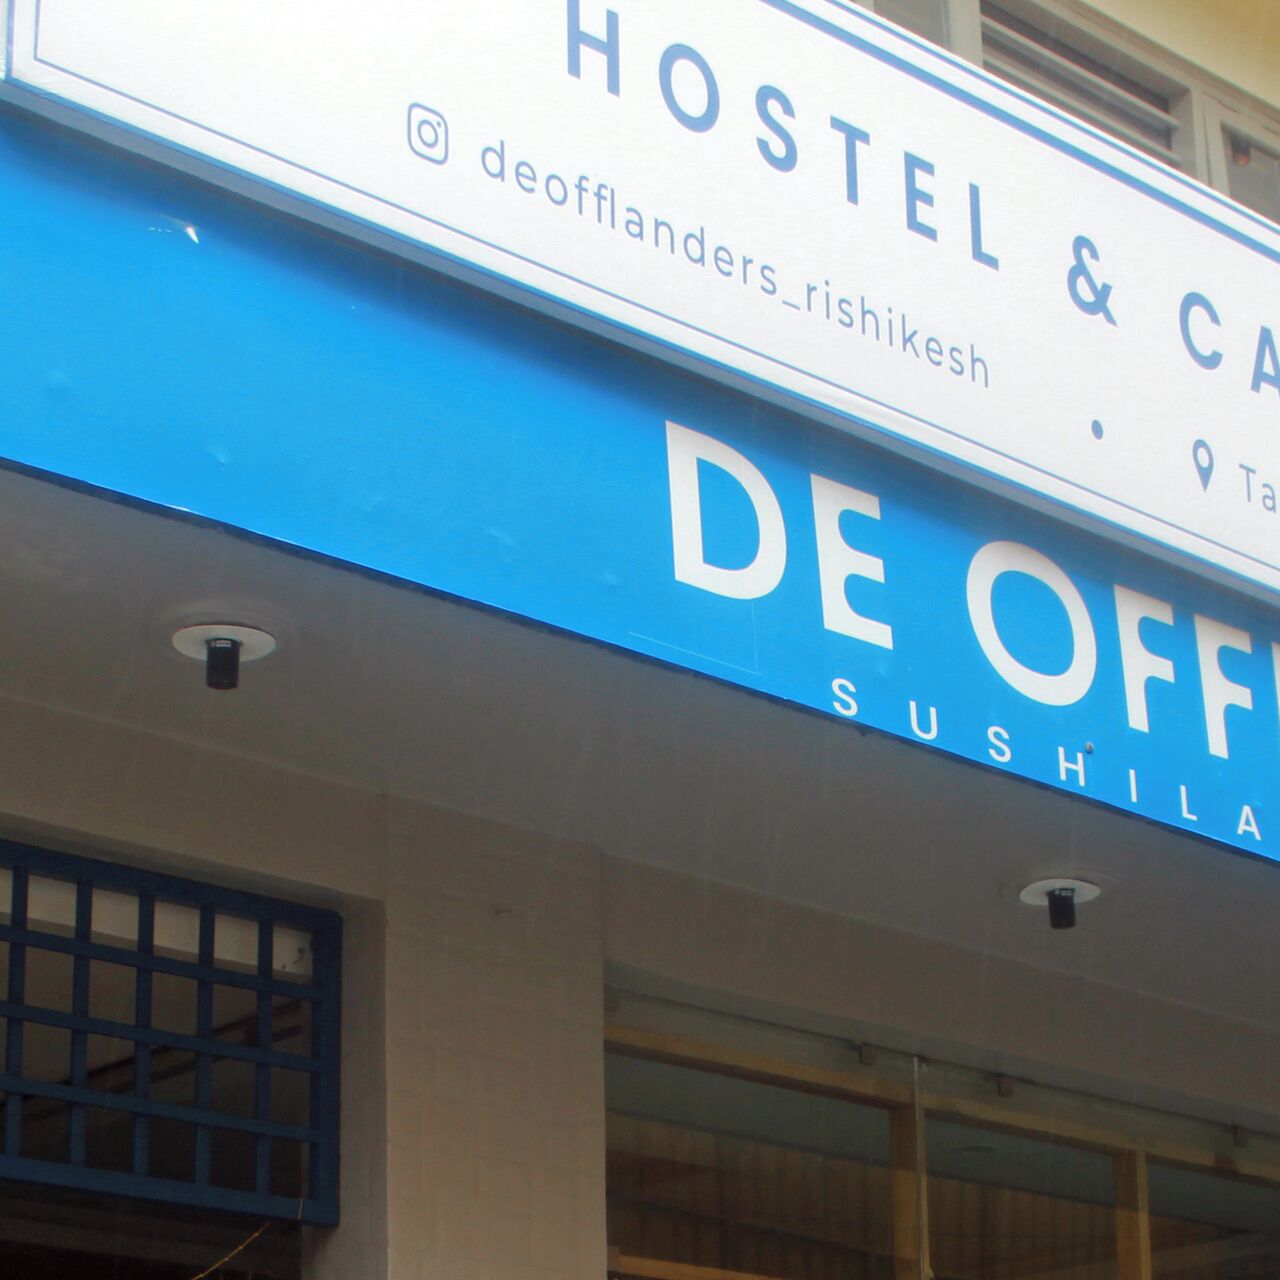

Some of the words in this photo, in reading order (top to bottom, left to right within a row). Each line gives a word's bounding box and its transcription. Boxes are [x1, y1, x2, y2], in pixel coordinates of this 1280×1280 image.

[480, 140, 991, 389] deofflanders_rishikesh
[566, 0, 1000, 272] HOSTEL
[1067, 234, 1118, 327] &
[666, 419, 893, 651] DE
[832, 675, 1264, 842] SUSHILA
